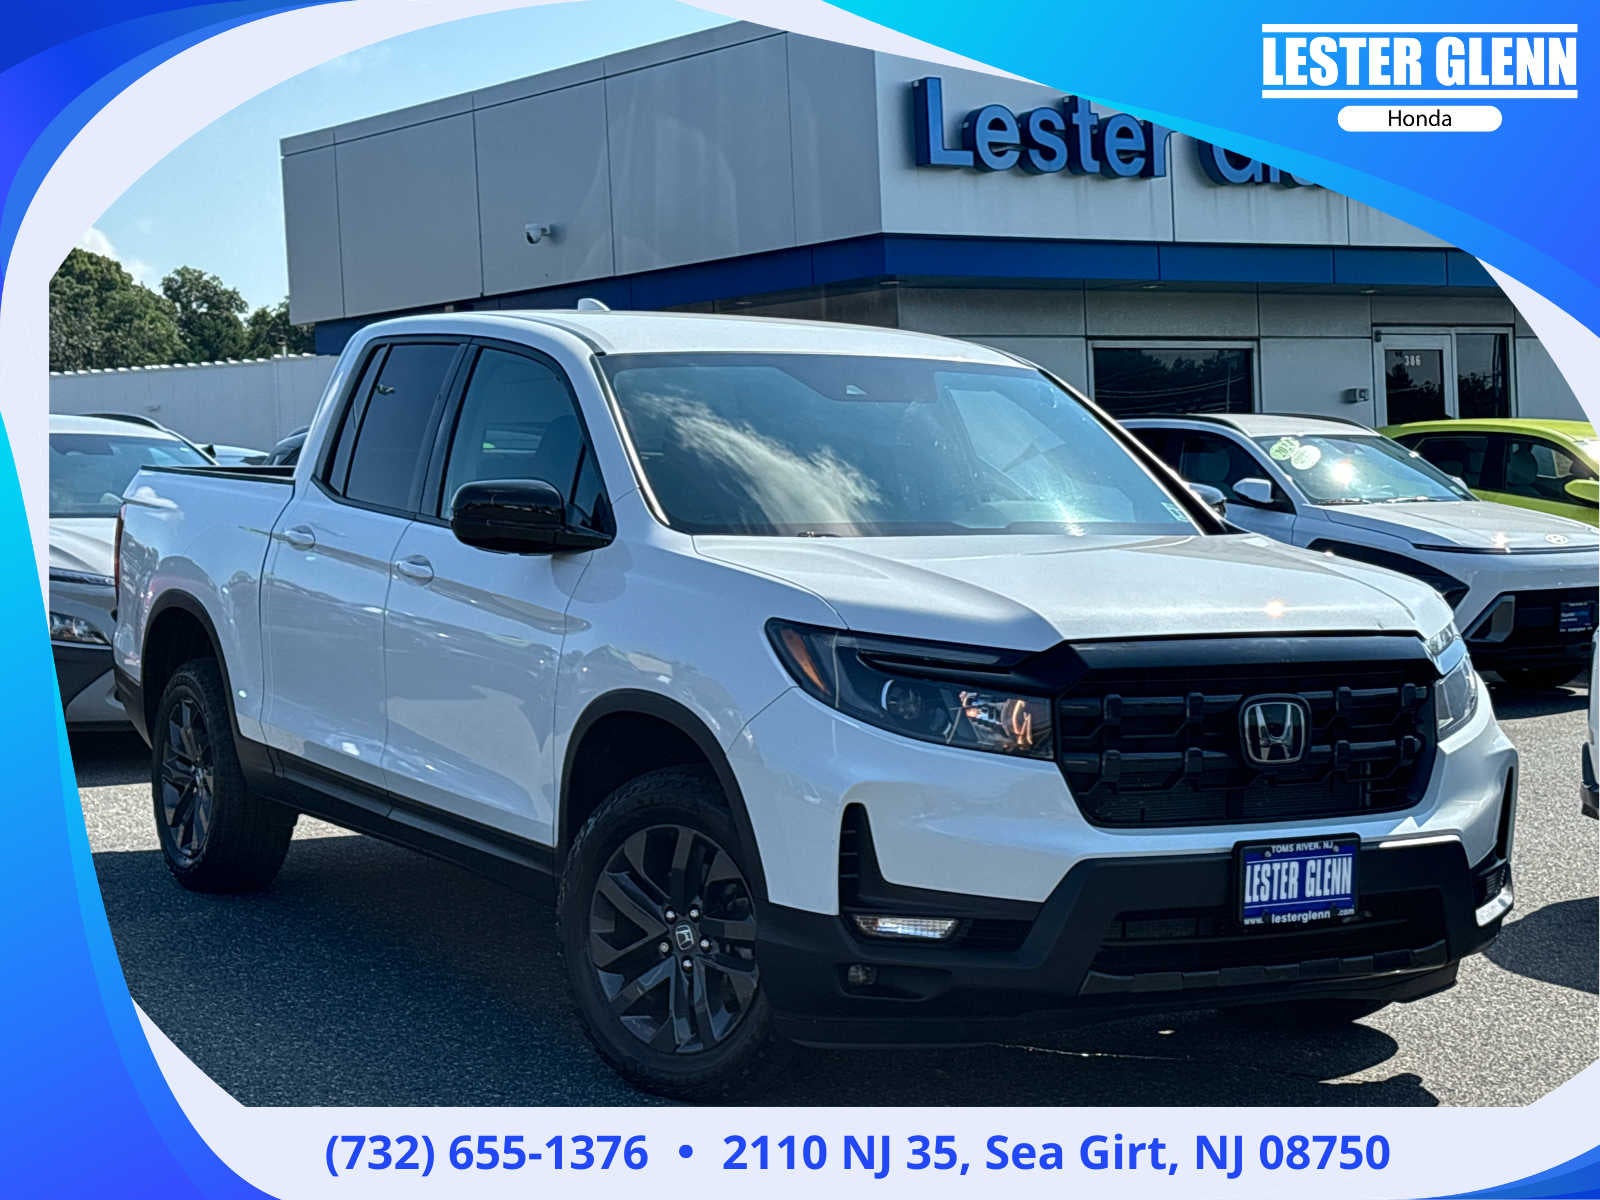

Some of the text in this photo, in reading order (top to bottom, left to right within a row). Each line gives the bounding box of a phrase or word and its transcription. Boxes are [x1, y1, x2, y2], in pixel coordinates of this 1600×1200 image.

[912, 76, 1173, 178] Lester
[1244, 857, 1352, 903] LESTER GLENN
